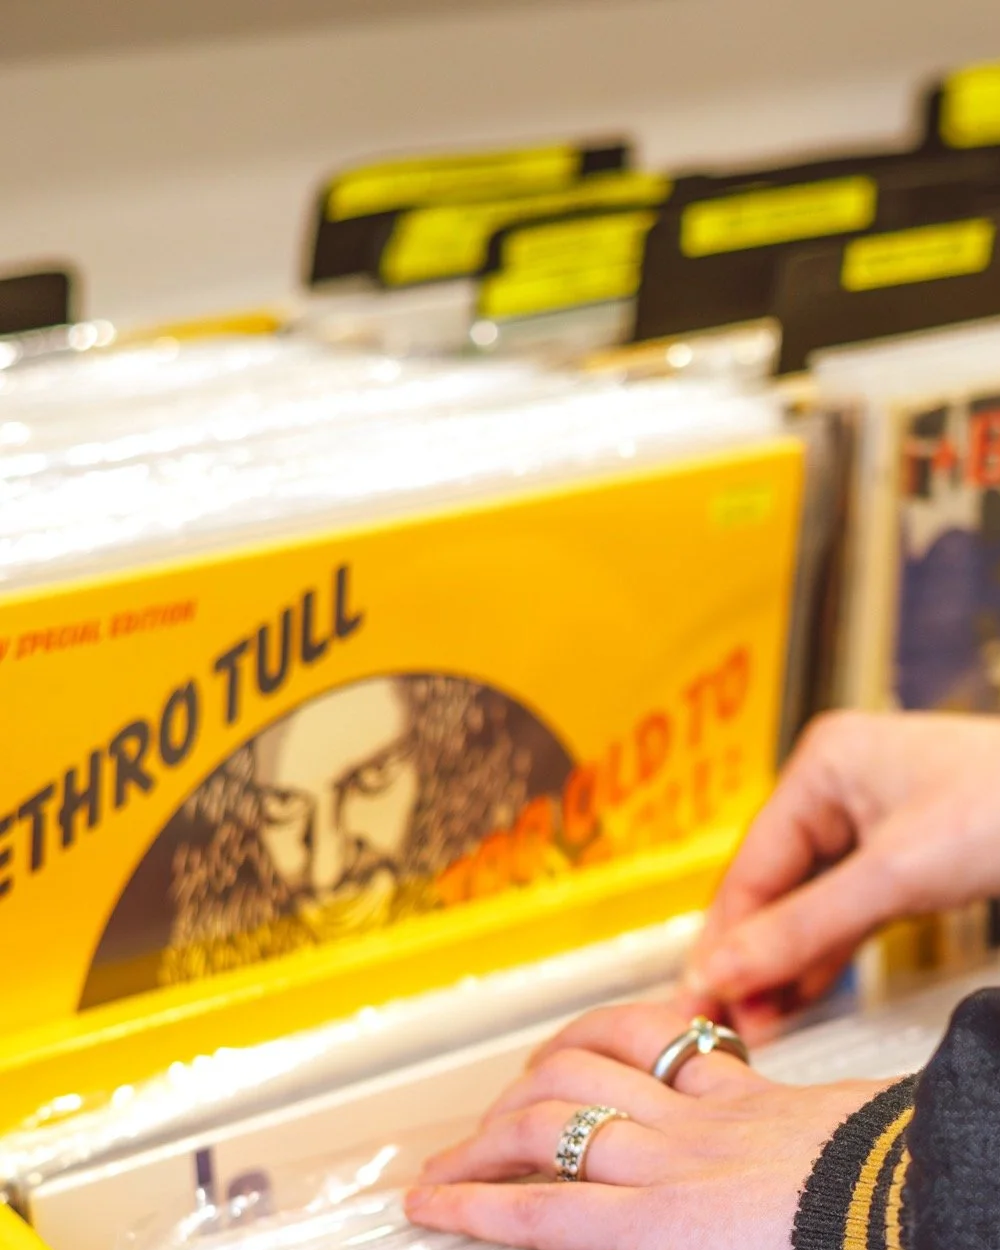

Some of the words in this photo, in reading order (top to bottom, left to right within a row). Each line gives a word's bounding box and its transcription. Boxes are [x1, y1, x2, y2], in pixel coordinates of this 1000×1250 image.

[109, 597, 200, 640] EDITION
[211, 564, 367, 728] TULL
[684, 642, 752, 758] TO
